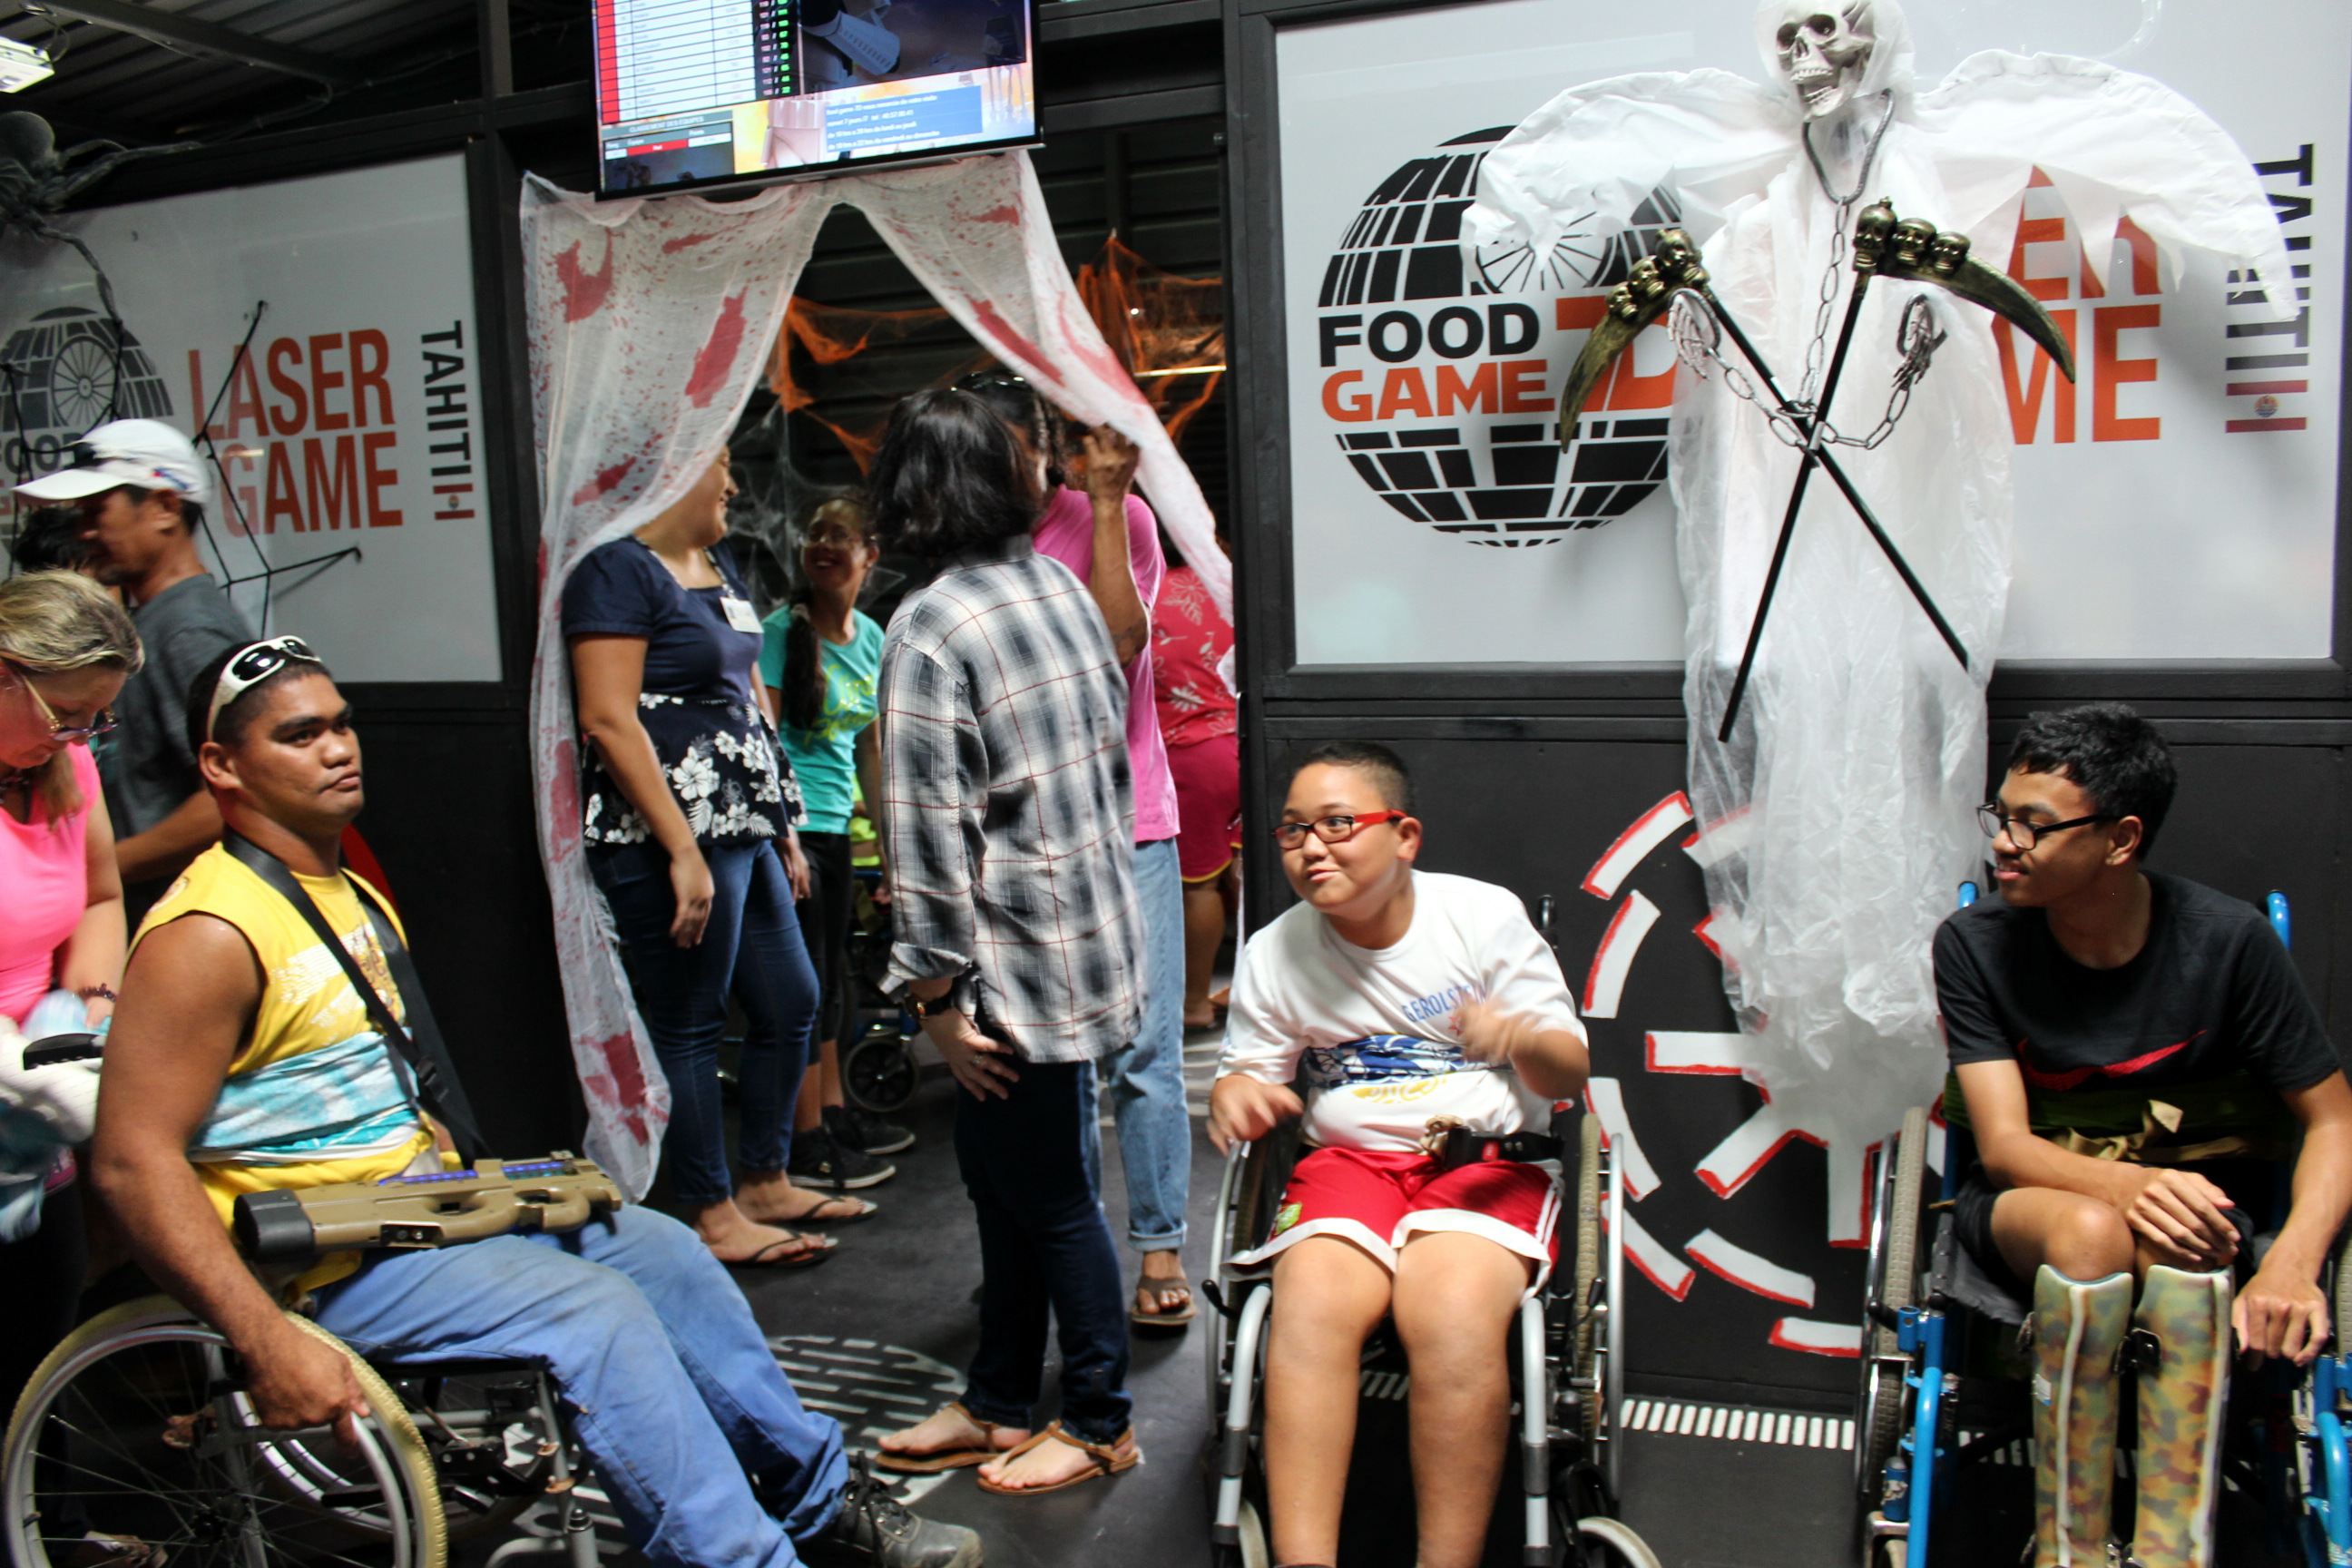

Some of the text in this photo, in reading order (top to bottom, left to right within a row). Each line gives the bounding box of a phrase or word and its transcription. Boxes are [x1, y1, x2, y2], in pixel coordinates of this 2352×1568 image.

[188, 328, 396, 441] LASER
[1318, 302, 1540, 368] FOOD
[420, 320, 472, 477] TAHITI
[1321, 358, 1554, 422] GAME
[220, 432, 403, 537] GAME
